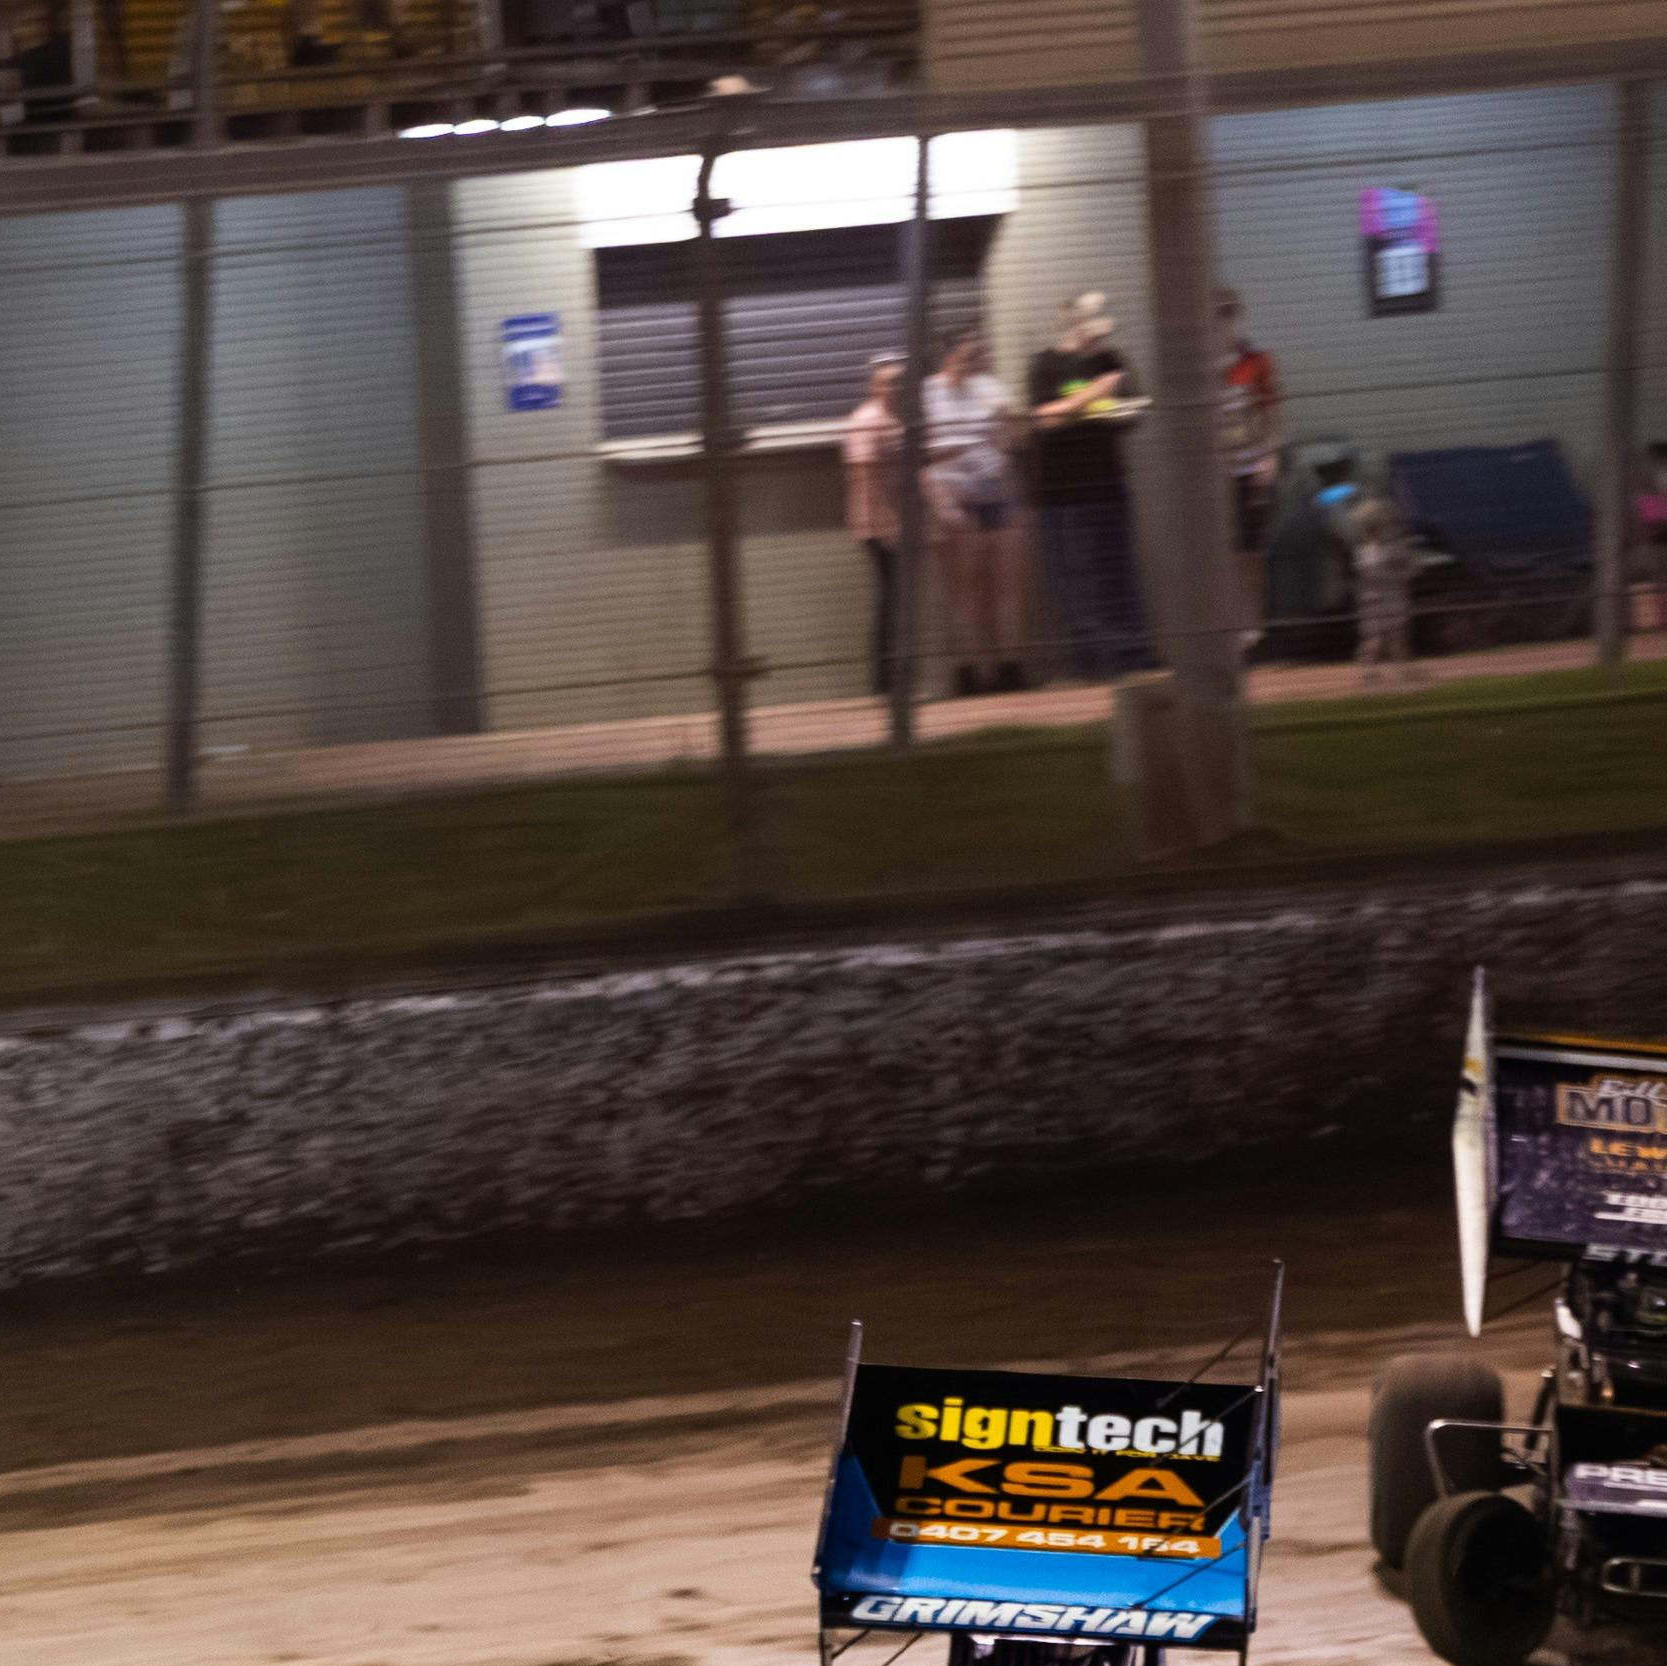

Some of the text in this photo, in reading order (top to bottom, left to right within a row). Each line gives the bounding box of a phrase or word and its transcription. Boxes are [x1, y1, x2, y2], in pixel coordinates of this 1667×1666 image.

[895, 1397, 1224, 1457] signtech
[899, 1455, 1206, 1508] KSA
[889, 1522, 1008, 1542] 0407
[1016, 1530, 1106, 1549] 454
[895, 1497, 1206, 1531] COURIER
[851, 1596, 1218, 1639] GRIMSHAW
